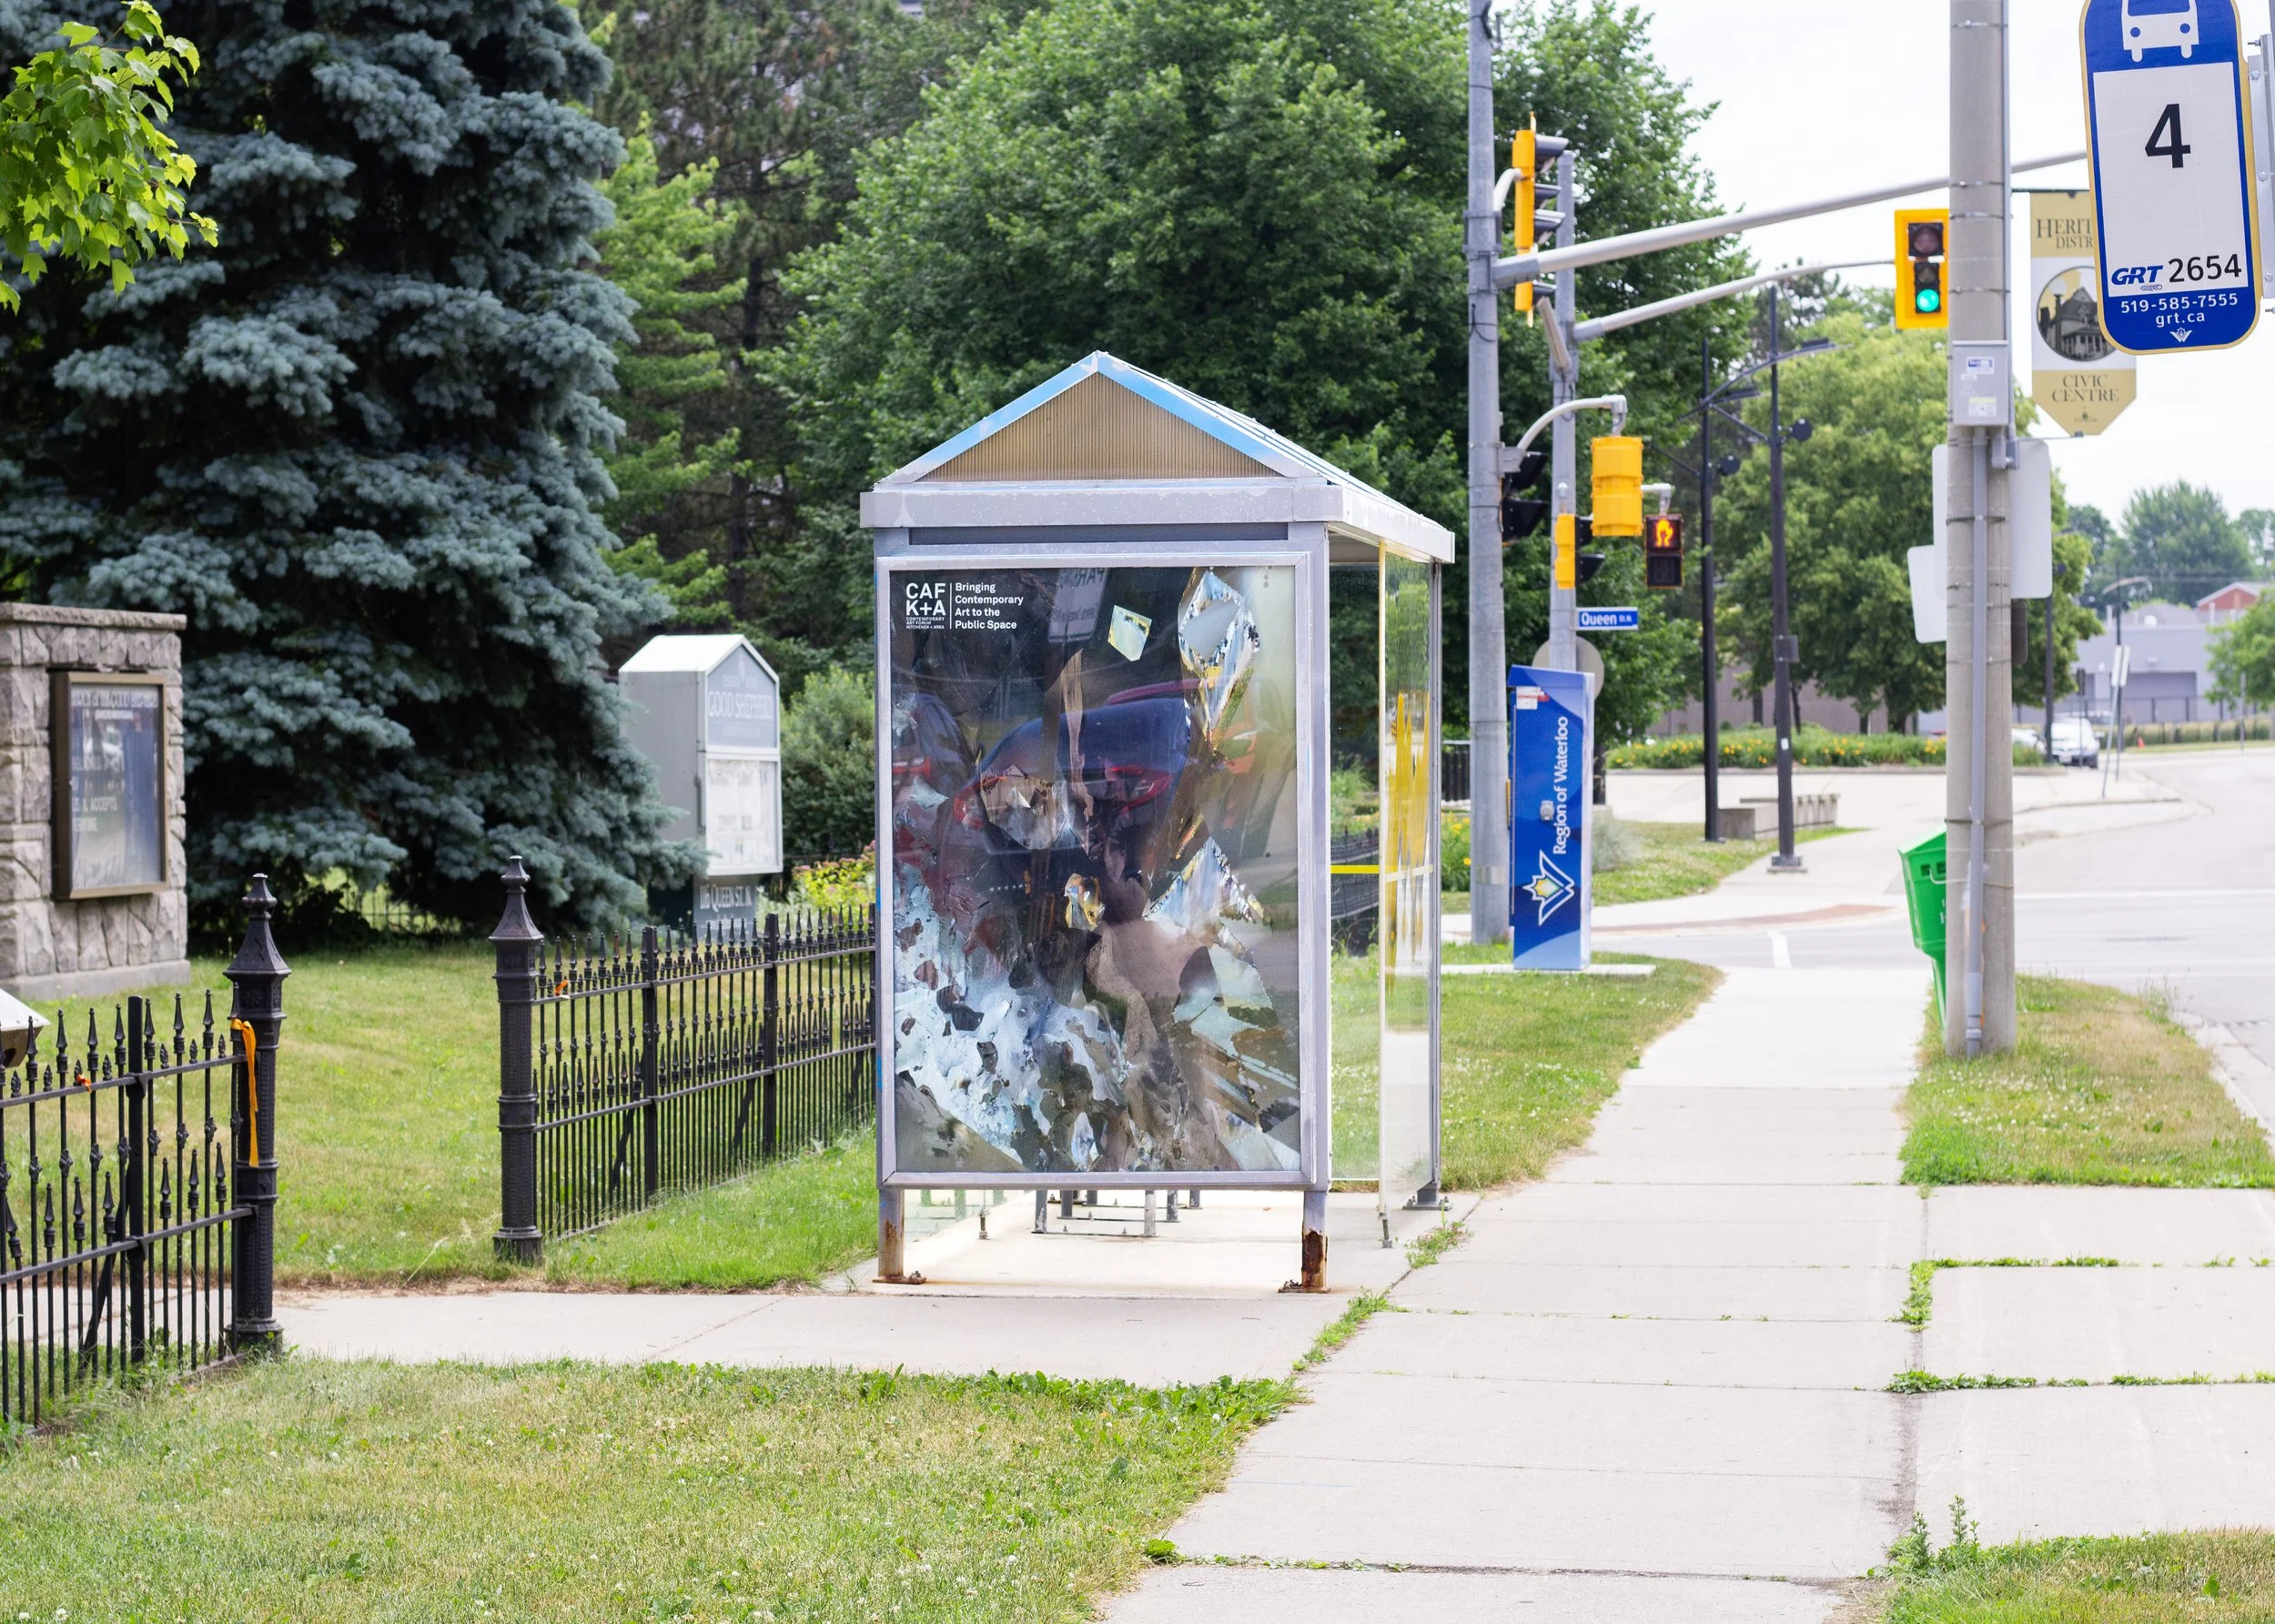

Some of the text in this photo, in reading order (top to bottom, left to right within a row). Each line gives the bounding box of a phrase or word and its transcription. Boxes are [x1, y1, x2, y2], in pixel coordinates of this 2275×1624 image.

[2145, 103, 2191, 168] 4
[2037, 218, 2092, 238] HERIT
[2056, 235, 2093, 249] DISTR
[2111, 254, 2241, 286] GRT 2654
[2121, 293, 2238, 314] 519-585-7555
[2156, 313, 2205, 328] grt.ca
[2062, 374, 2108, 388] CIVIC
[2051, 388, 2119, 402] CENTRE
[905, 583, 946, 600] CAF
[955, 582, 996, 593] Bringing
[905, 600, 946, 616] K+A
[955, 595, 1024, 606] Contemporary
[955, 608, 1000, 617] Art to the
[1581, 612, 1617, 626] Queen
[955, 620, 1017, 631] Public Space
[709, 691, 733, 717] GOOD
[1552, 716, 1571, 855] Region of Waterloo
